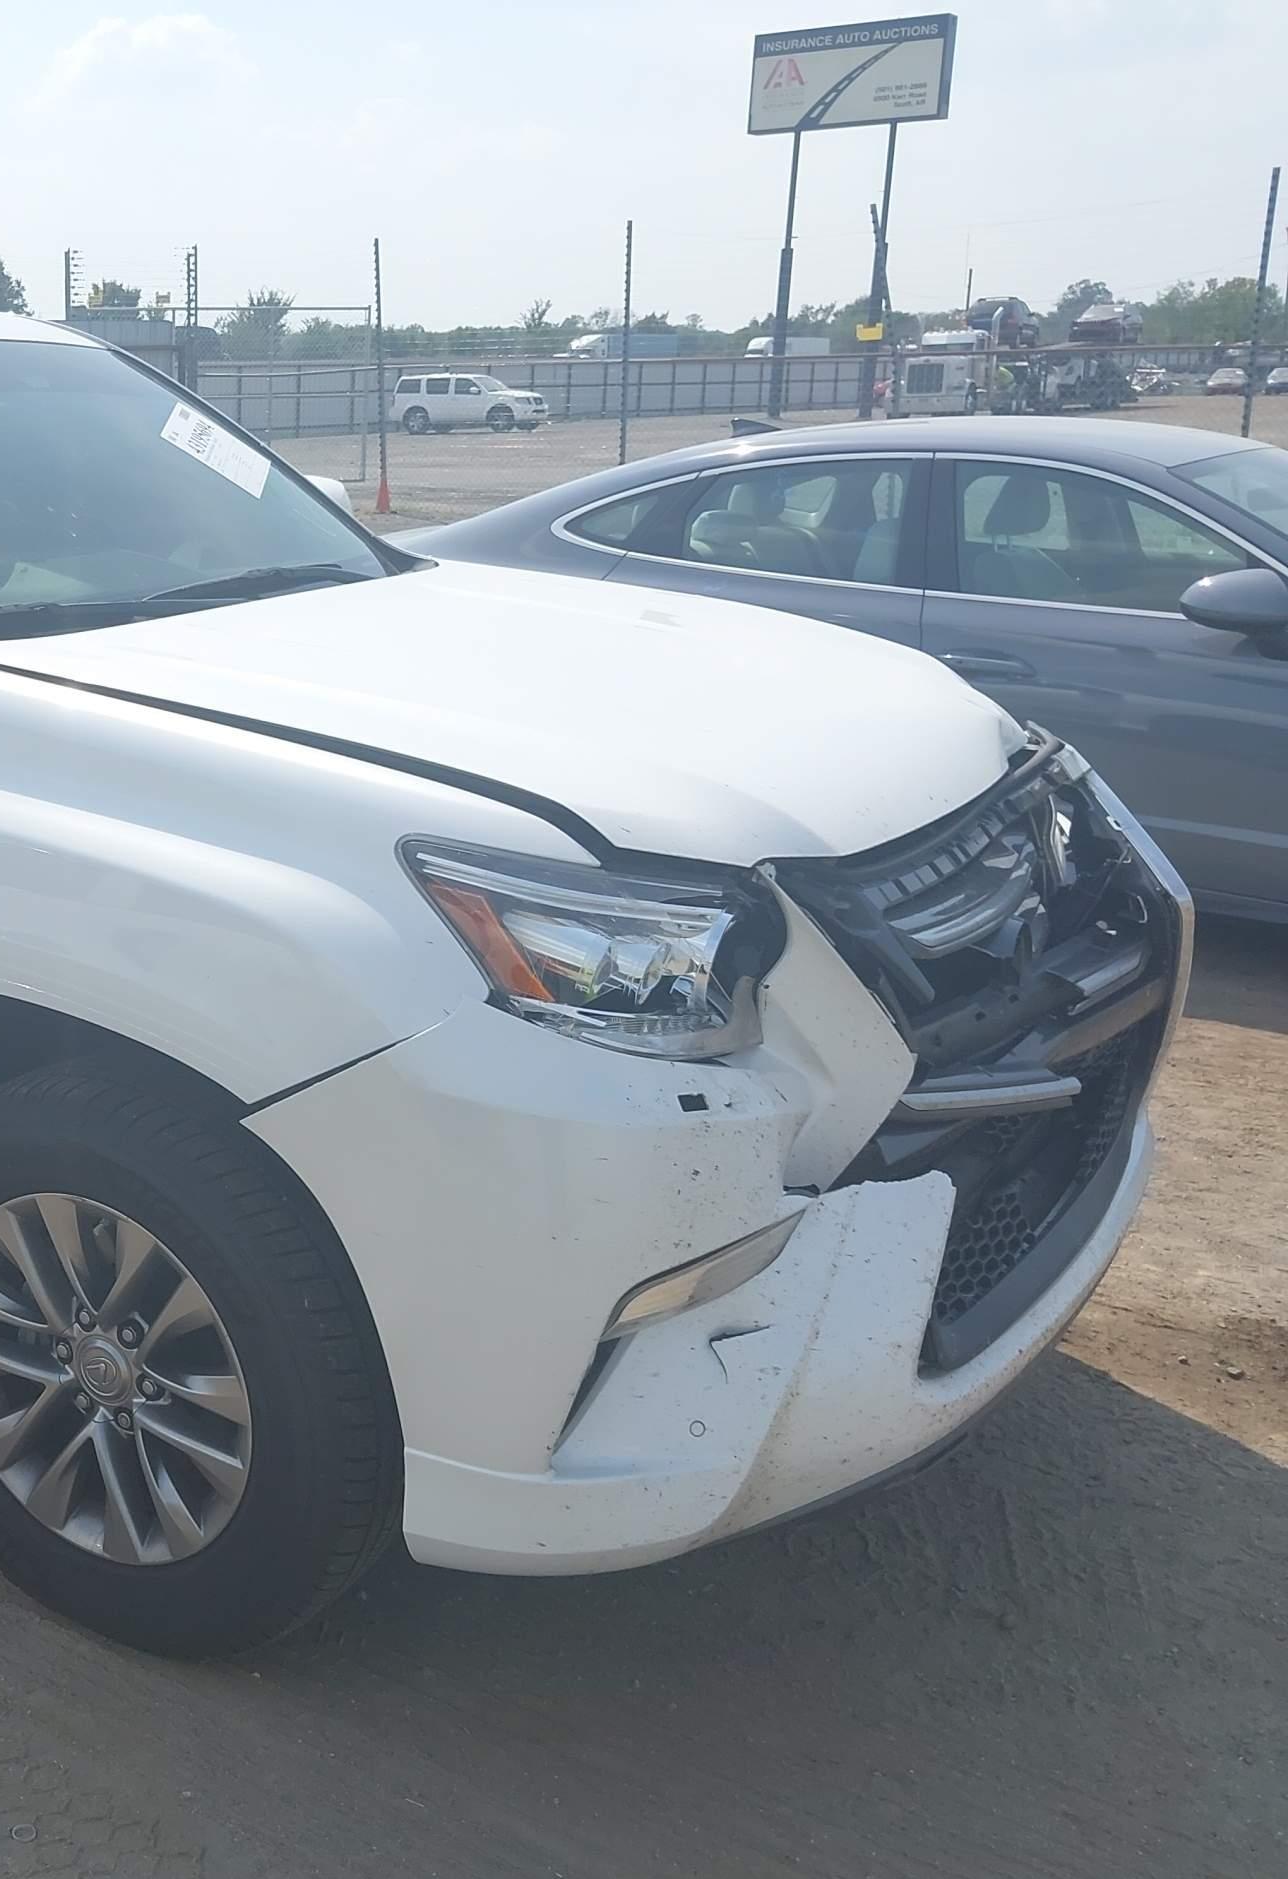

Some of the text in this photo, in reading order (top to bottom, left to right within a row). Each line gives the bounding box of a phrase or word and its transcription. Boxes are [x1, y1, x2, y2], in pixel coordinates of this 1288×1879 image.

[762, 23, 939, 53] INSURANCE AUTO AUCTIONS
